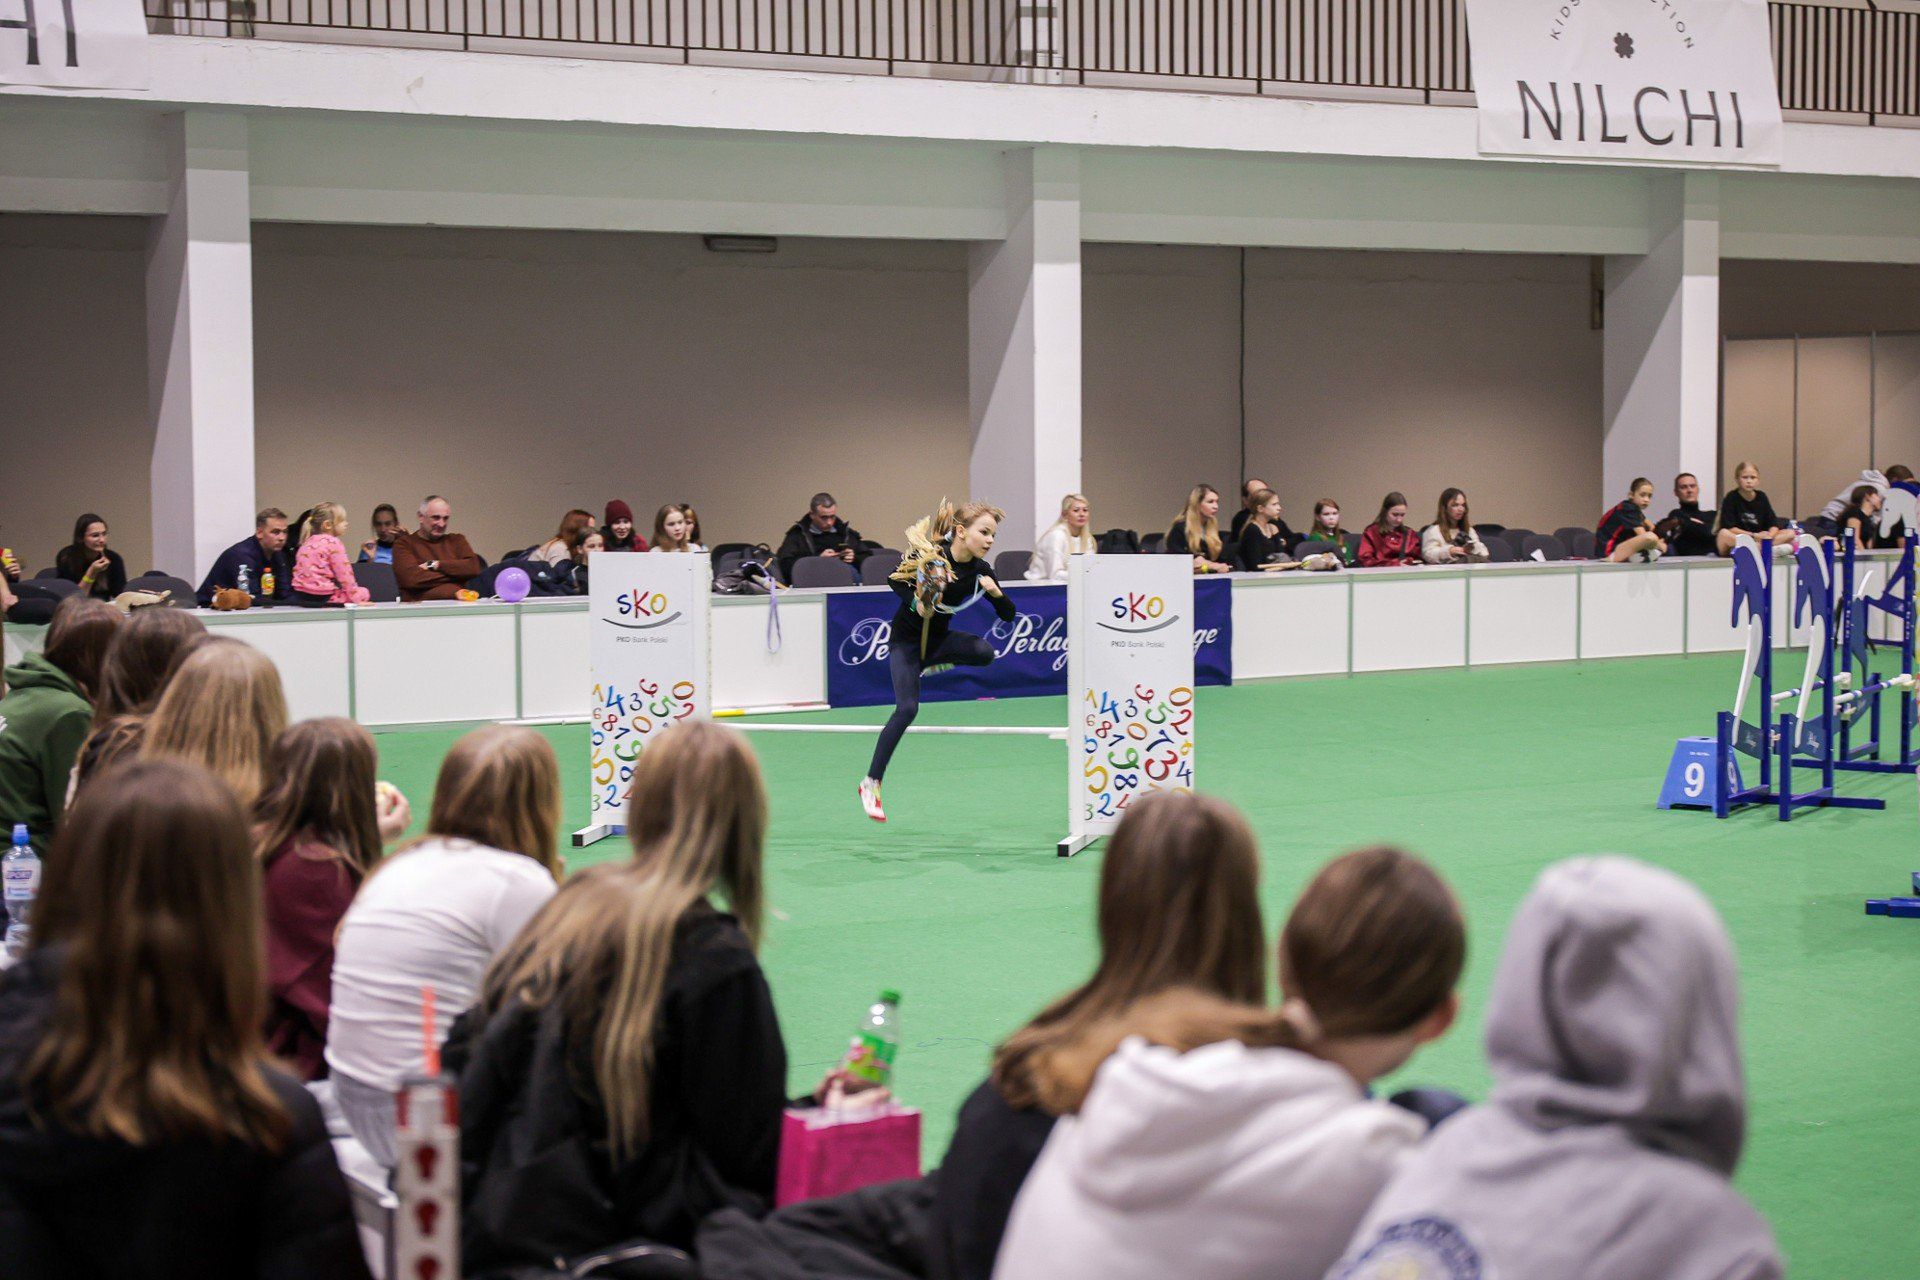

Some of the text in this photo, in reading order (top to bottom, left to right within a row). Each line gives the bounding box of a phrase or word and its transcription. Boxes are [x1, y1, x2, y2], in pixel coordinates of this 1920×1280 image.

[1516, 79, 1744, 149] NILCHI
[616, 588, 668, 619] SKO
[1111, 591, 1164, 623] SKO
[605, 685, 625, 716] 4
[630, 693, 643, 711] 3
[1086, 689, 1098, 709] 1
[1099, 691, 1119, 724] 4
[1124, 698, 1138, 718] 3
[592, 707, 602, 719] 6
[602, 713, 618, 731] 8
[1086, 713, 1096, 727] 6
[1170, 709, 1192, 735] 2
[1095, 720, 1112, 739] 8
[1084, 755, 1109, 794] 5
[1144, 750, 1178, 781] 3
[1176, 760, 1193, 787] 4
[1114, 773, 1138, 791] 8
[1684, 762, 1705, 798] 9
[604, 784, 622, 808] 2
[1097, 792, 1115, 817] 2
